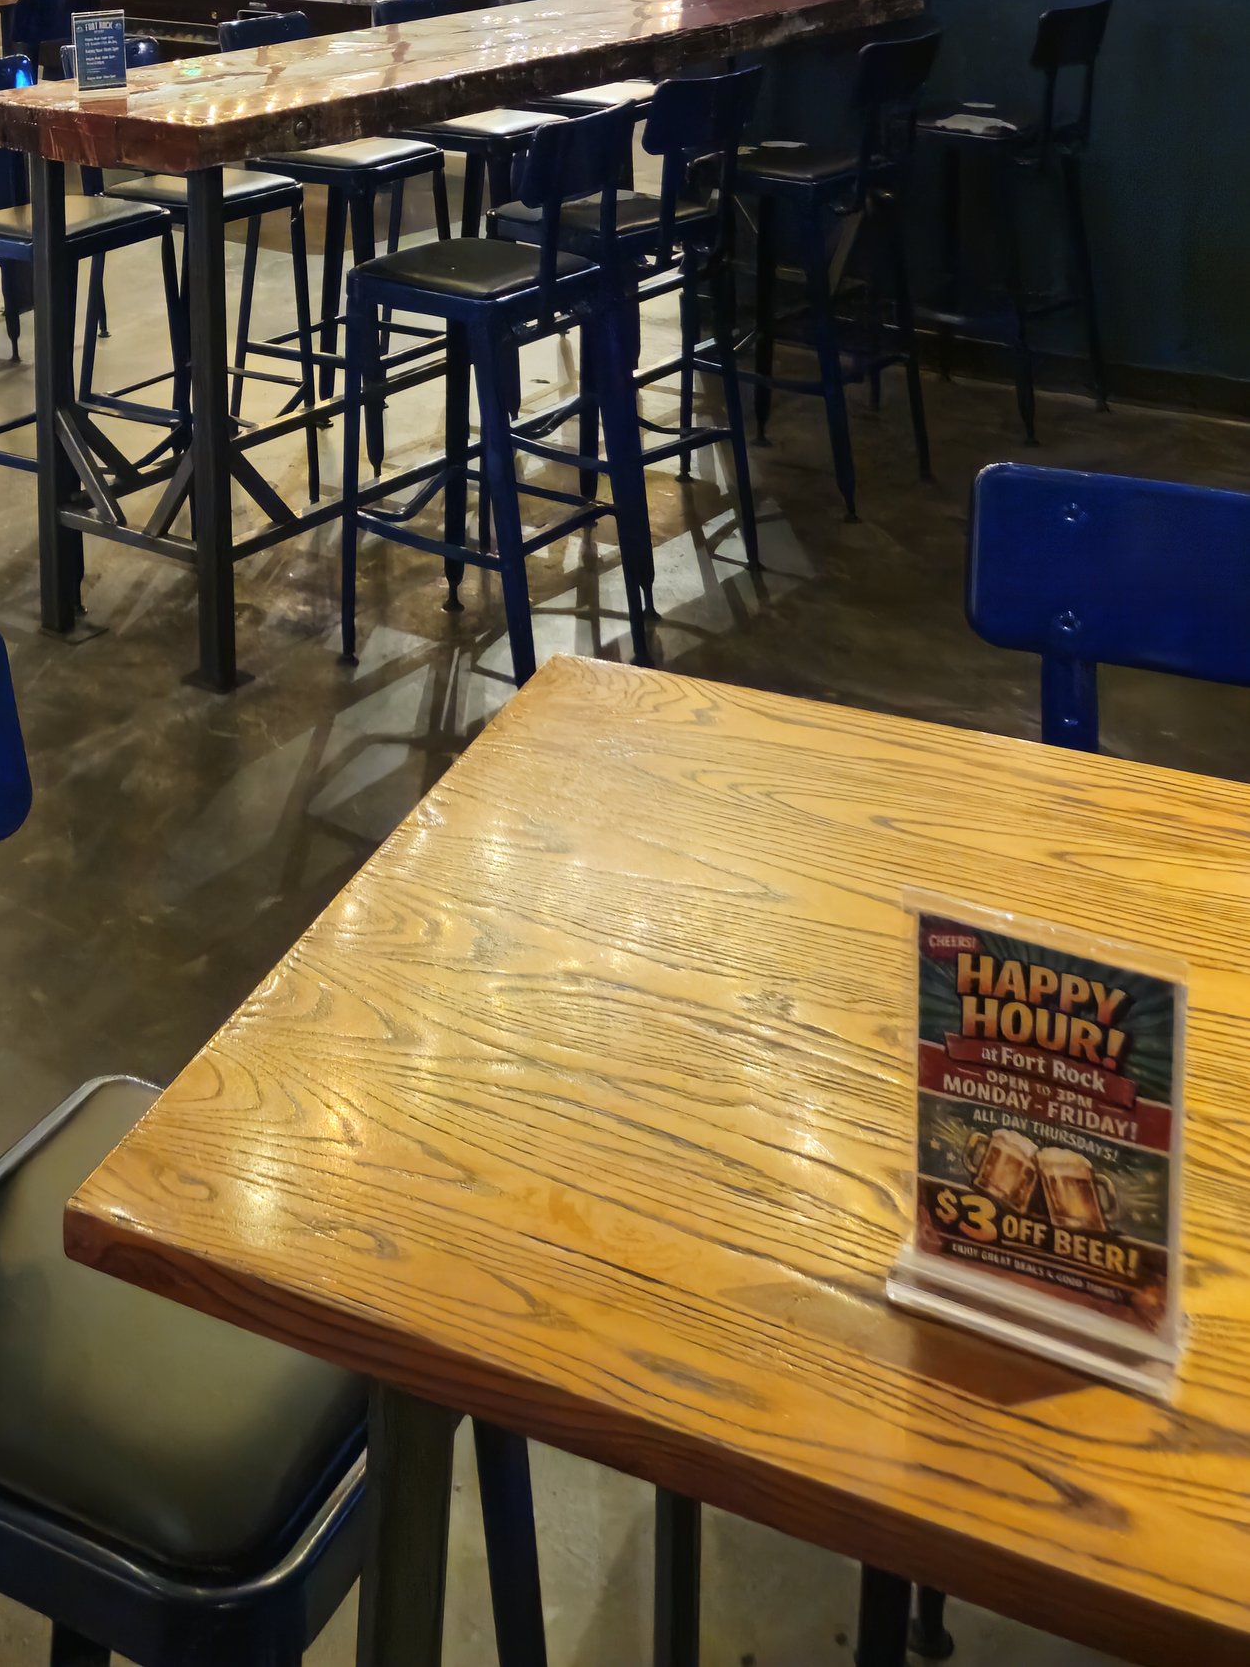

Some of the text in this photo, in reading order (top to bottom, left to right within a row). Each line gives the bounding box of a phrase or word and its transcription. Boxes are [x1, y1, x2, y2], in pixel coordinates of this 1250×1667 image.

[929, 935, 975, 949] CHEERS!
[957, 953, 1126, 1025] HAPPY
[961, 995, 1125, 1069] HOUR!
[981, 1047, 1105, 1093] at Fort Rock
[986, 1070, 1030, 1093] OPEN
[1056, 1088, 1093, 1108] 3PM
[943, 1074, 1032, 1111] MONDAY
[1047, 1101, 1138, 1140] FRIDAY!
[973, 1109, 1118, 1163] ALL DAY THURSDAYS!
[935, 1188, 1139, 1278] $3 OFF BEER!
